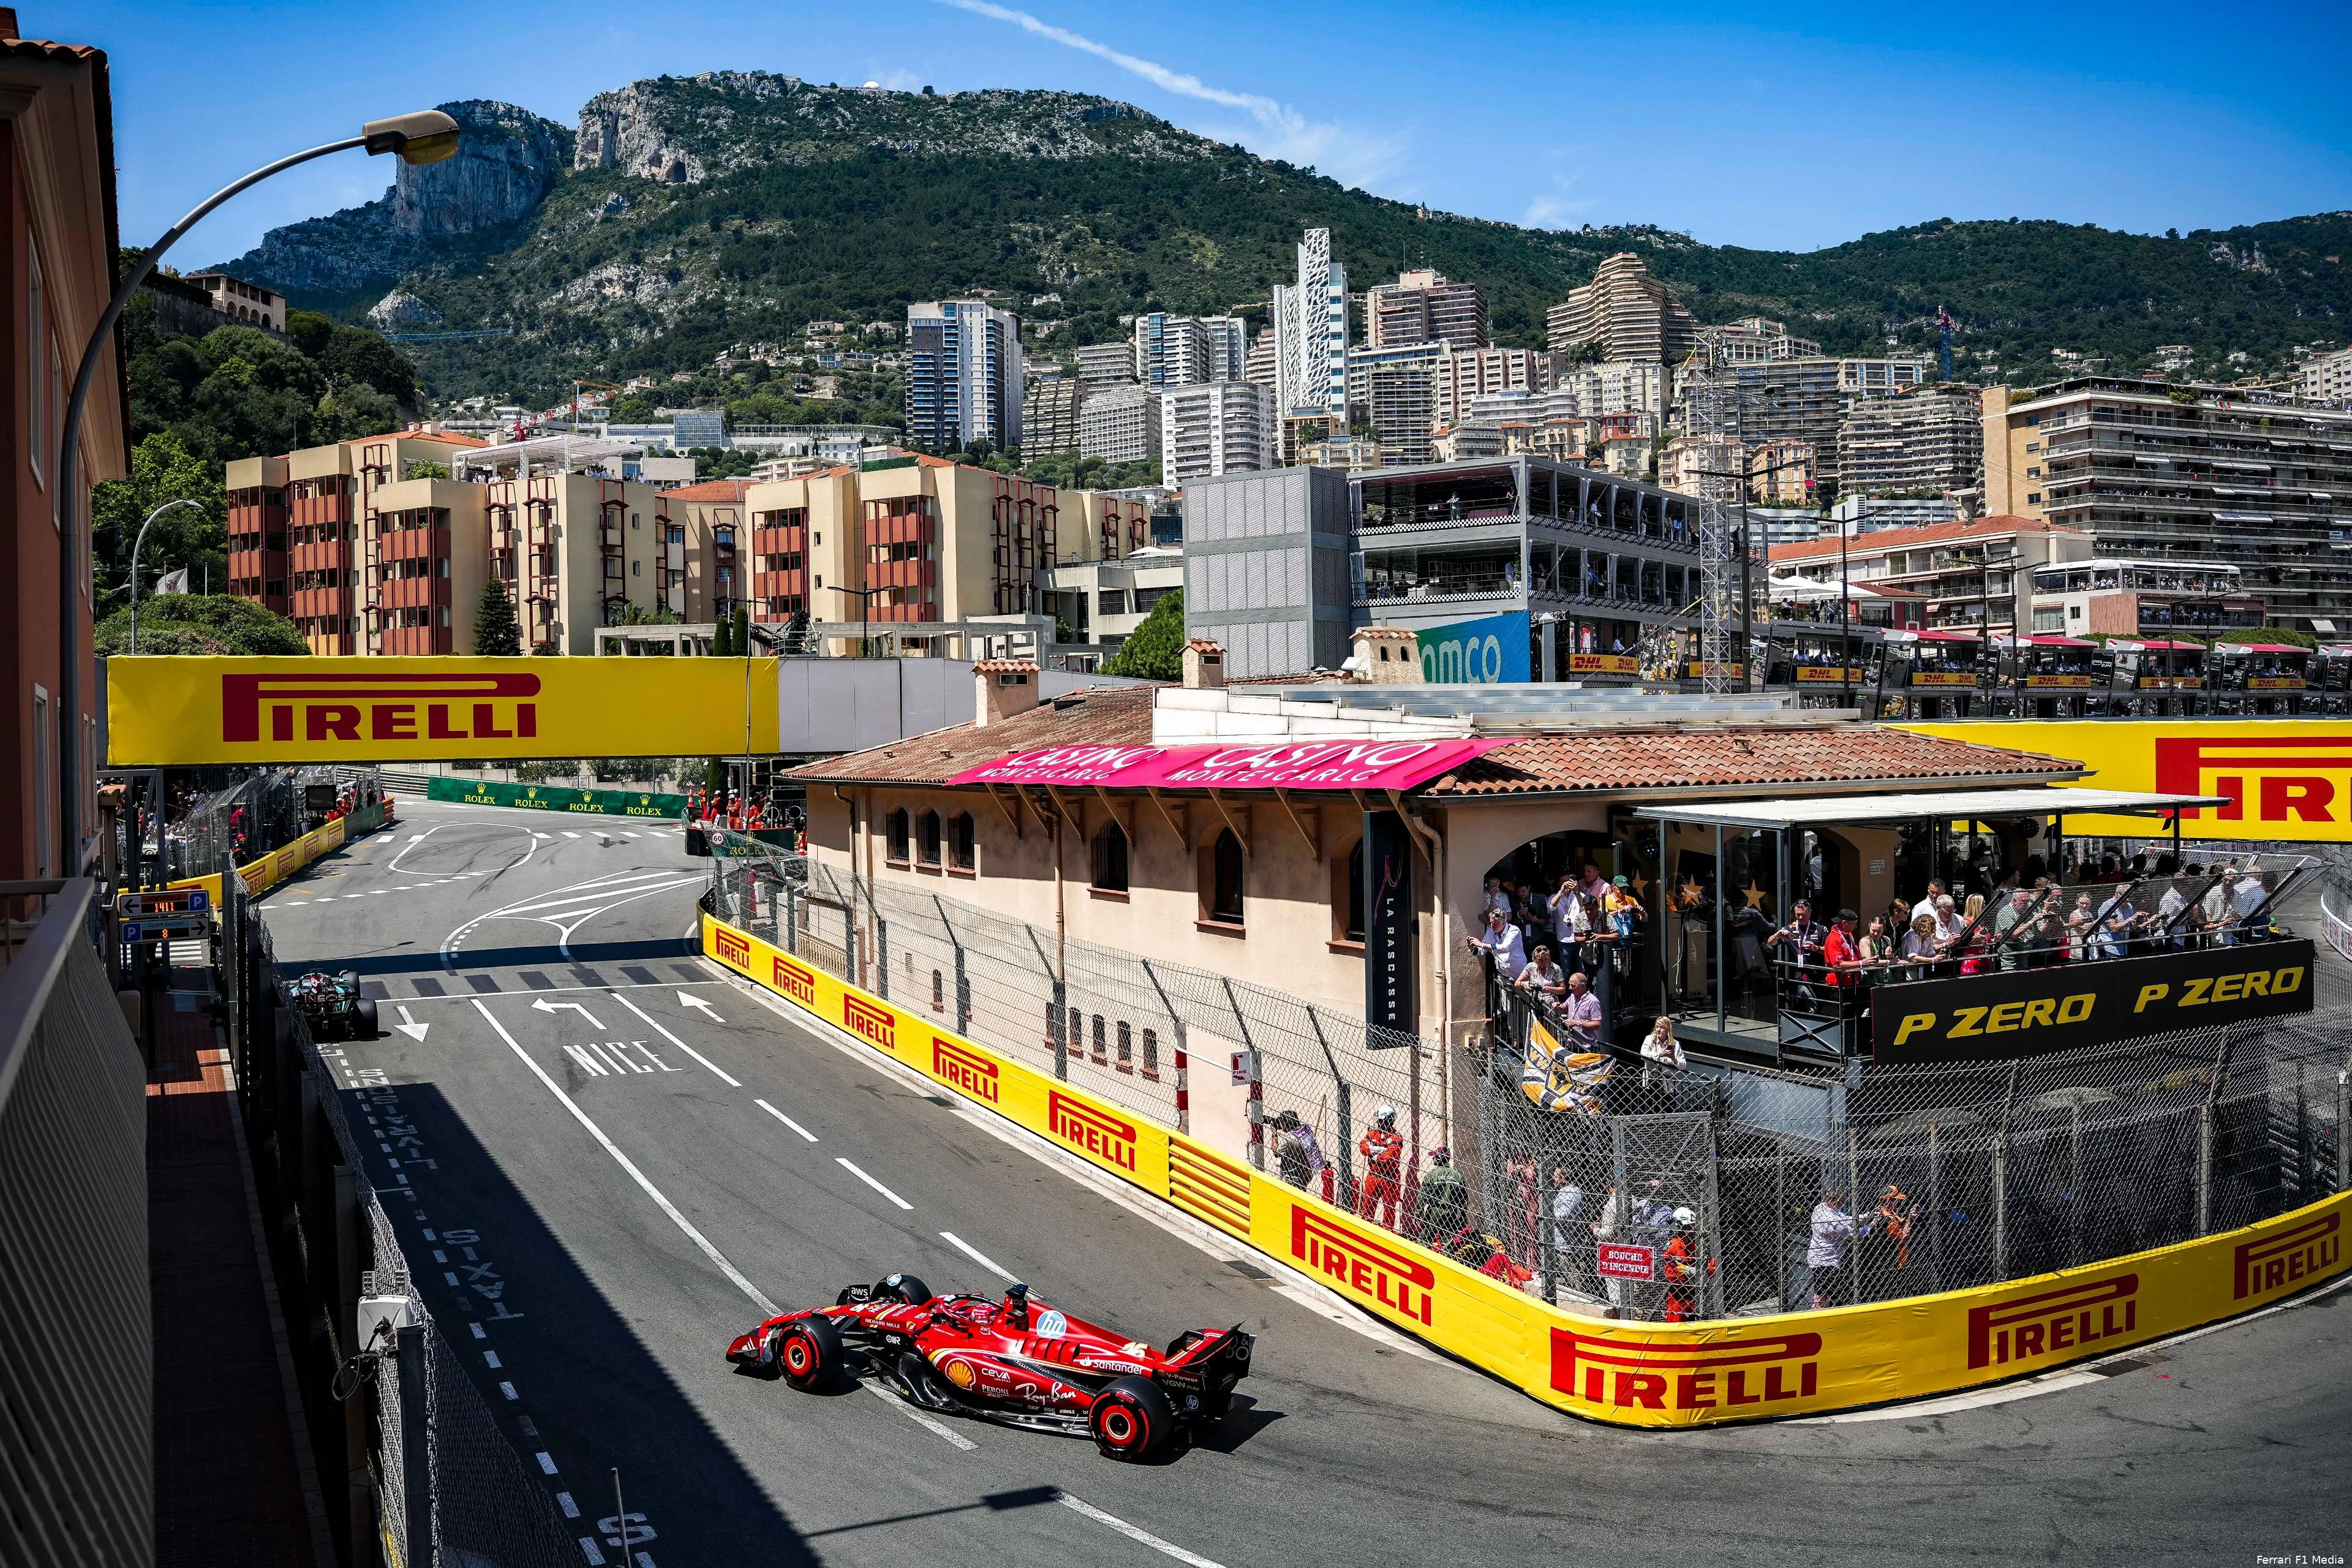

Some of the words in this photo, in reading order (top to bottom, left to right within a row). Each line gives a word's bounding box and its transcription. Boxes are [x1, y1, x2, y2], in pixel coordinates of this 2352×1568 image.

[1574, 657, 1602, 669] DHL
[1618, 658, 1634, 670] DHL
[1809, 669, 1831, 678] DHL
[222, 673, 541, 742] PIRELLI
[1007, 747, 1169, 768] CASINO
[1204, 742, 1437, 767] CASINO
[2155, 737, 2352, 822] PIR
[465, 795, 495, 804] ROLEX
[515, 799, 548, 809] ROLEX
[570, 804, 604, 813] ROLEX
[627, 807, 662, 816] ROLEX
[328, 824, 342, 847] PIRELLI
[304, 834, 319, 860] PIRELLI
[277, 850, 295, 876] PIRELLI
[155, 902, 175, 912] 1411
[194, 896, 202, 907] P
[1387, 898, 1394, 917] LA
[127, 927, 136, 938] P
[162, 929, 168, 938] 8
[716, 928, 749, 970] PIRELLI
[773, 956, 814, 1005] PIRELLI
[1387, 927, 1395, 1020] RASCASSE
[304, 993, 345, 1003] INEOS
[2133, 983, 2169, 1013] P
[2177, 966, 2304, 1008] ZERO
[844, 993, 894, 1050] PIRELLI
[1893, 1012, 1936, 1046] P
[1947, 993, 2097, 1038] ZERO
[562, 1040, 683, 1076] NICE
[933, 1037, 998, 1103] PIRELLI
[1049, 1090, 1136, 1171] PIRELLI
[1292, 1204, 1434, 1327] PIRELLI
[1608, 1251, 1643, 1262] BOUCHE
[2234, 1212, 2340, 1300] PIRELLI
[851, 1287, 868, 1296] aws
[1039, 1310, 1065, 1338] hp
[1968, 1273, 2139, 1370] PIRELLI
[1093, 1359, 1144, 1375] Santander
[1166, 1373, 1198, 1382] V-Power
[1550, 1327, 1822, 1409] PIRELLI
[982, 1384, 1009, 1395] PERONI
[1162, 1379, 1185, 1388] VGW
[1188, 1396, 1197, 1409] hp
